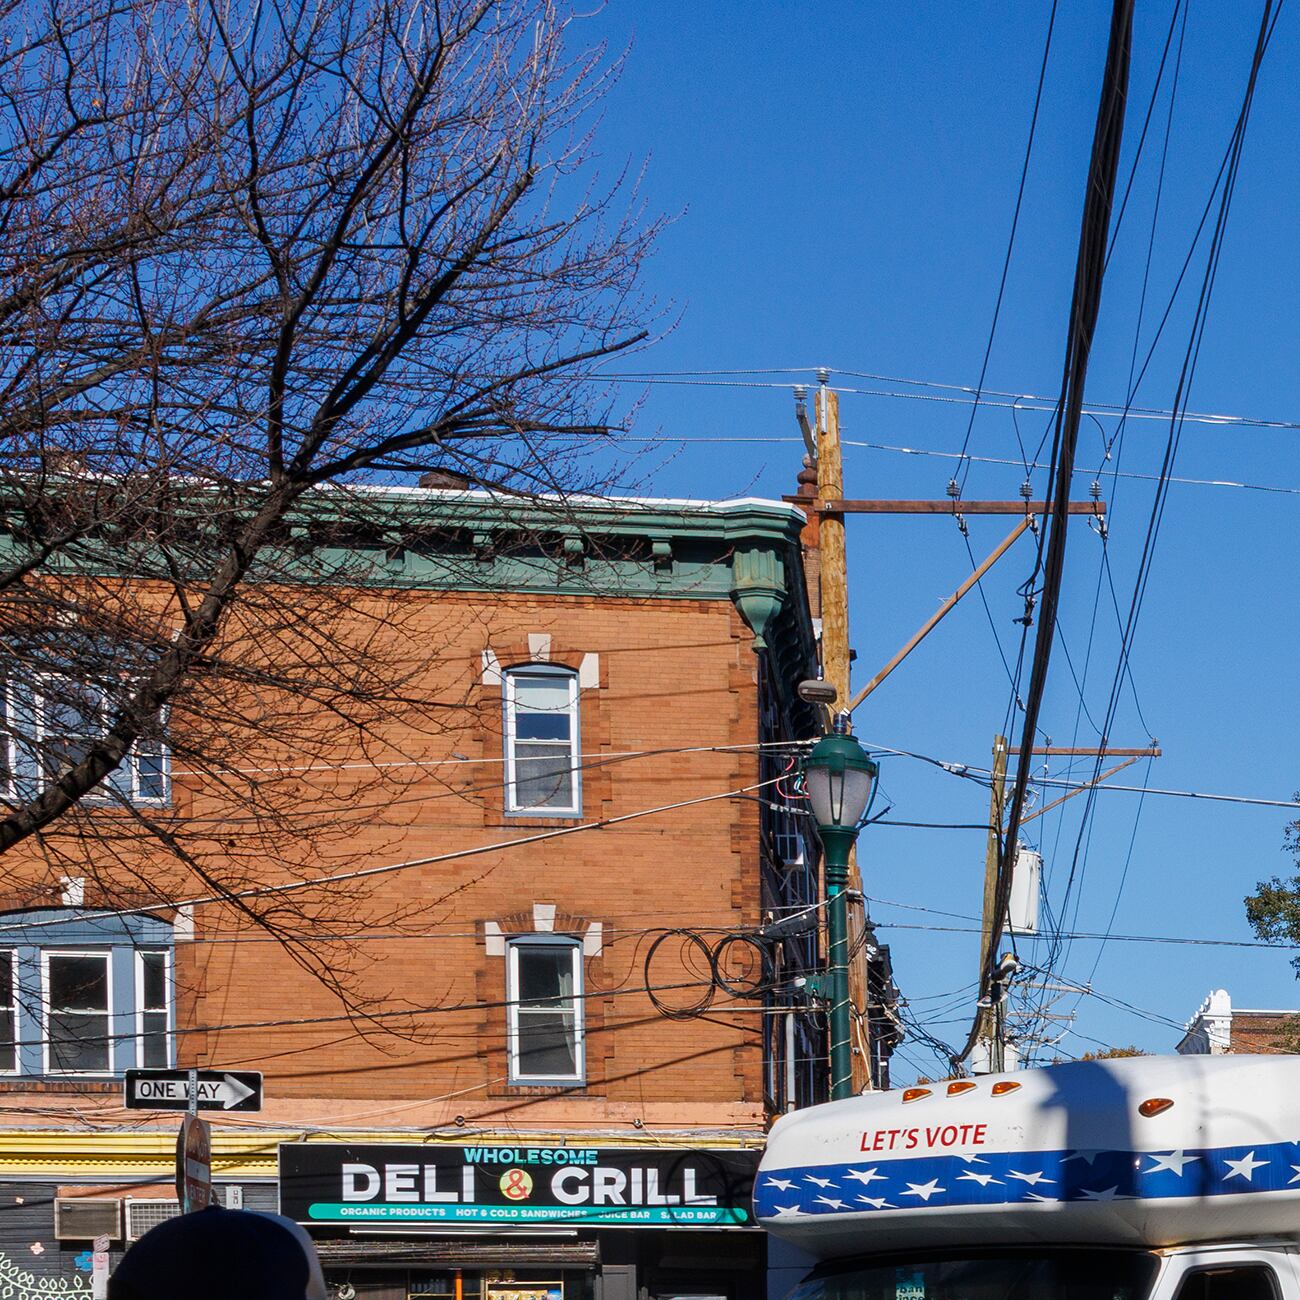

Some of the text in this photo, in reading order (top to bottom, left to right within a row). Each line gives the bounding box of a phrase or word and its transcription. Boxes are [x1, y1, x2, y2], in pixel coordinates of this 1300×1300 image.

[140, 1082, 176, 1098] ONE
[860, 1124, 987, 1152] LET'S VOTE
[463, 1148, 598, 1165] WHOLESOME
[342, 1163, 717, 1205] DELI & GRILL
[340, 1207, 445, 1216] ORGANIC PRODUCTS
[456, 1208, 478, 1217] HOT
[490, 1209, 518, 1217] COLD
[521, 1209, 587, 1218] SANDWICHES
[630, 1211, 650, 1219] BAR
[660, 1211, 716, 1220] SALAD BAR
